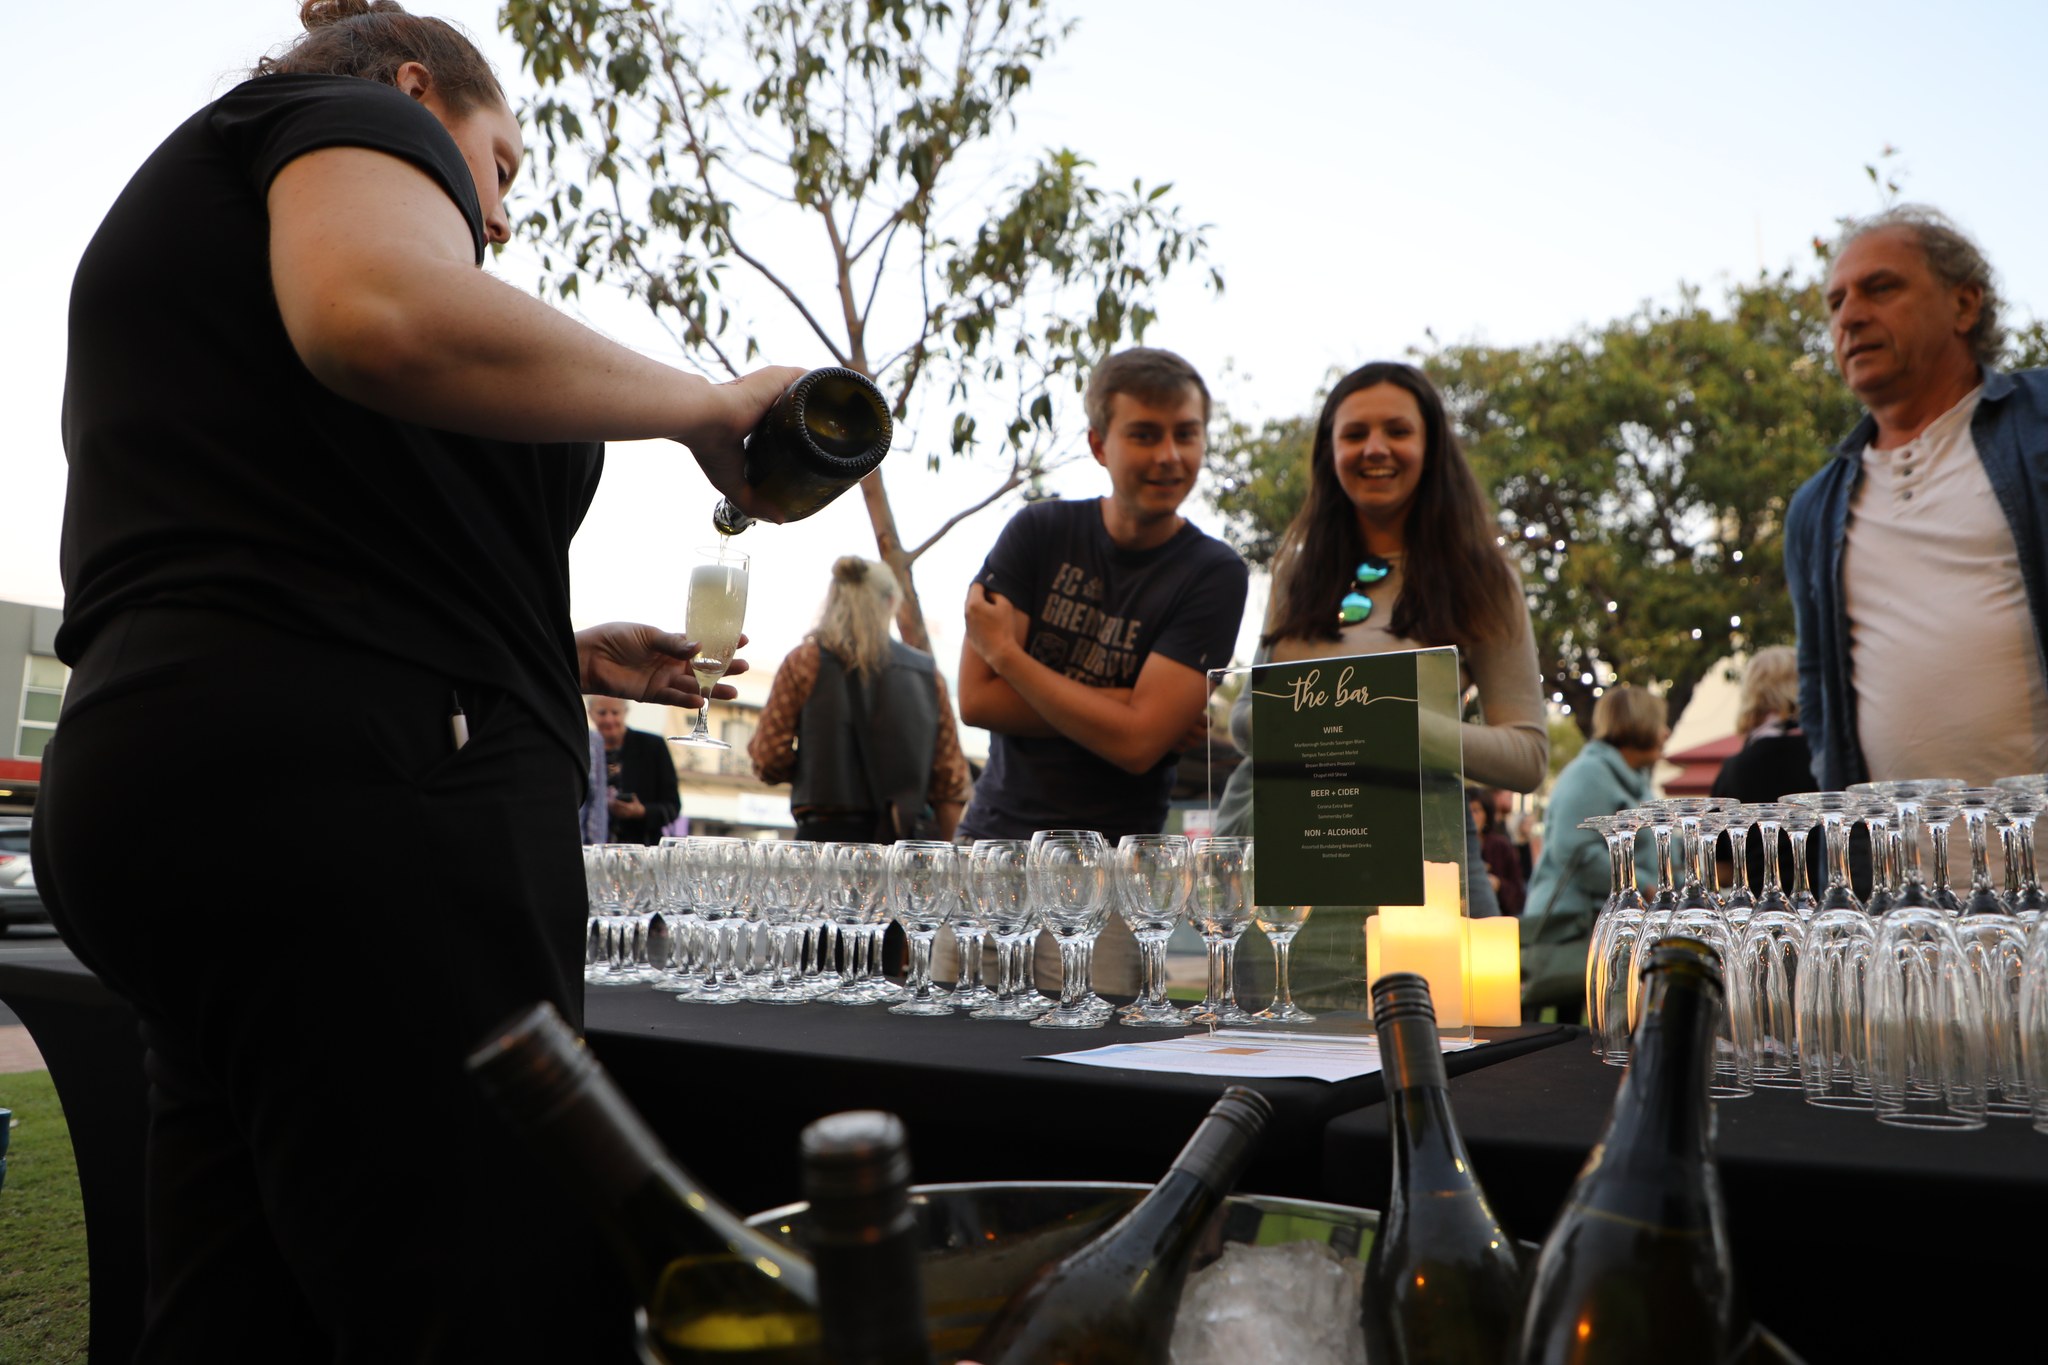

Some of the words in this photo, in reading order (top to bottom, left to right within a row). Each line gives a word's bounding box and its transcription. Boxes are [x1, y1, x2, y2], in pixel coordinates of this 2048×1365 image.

[1052, 562, 1085, 597] FC
[1287, 668, 1329, 712] the
[1334, 665, 1372, 708] bar
[1323, 725, 1344, 734] WINE
[1310, 789, 1330, 797] BEER
[1337, 788, 1360, 796] CIDER
[1304, 829, 1321, 837] NON
[1327, 827, 1369, 836] ALCOHOLIC
